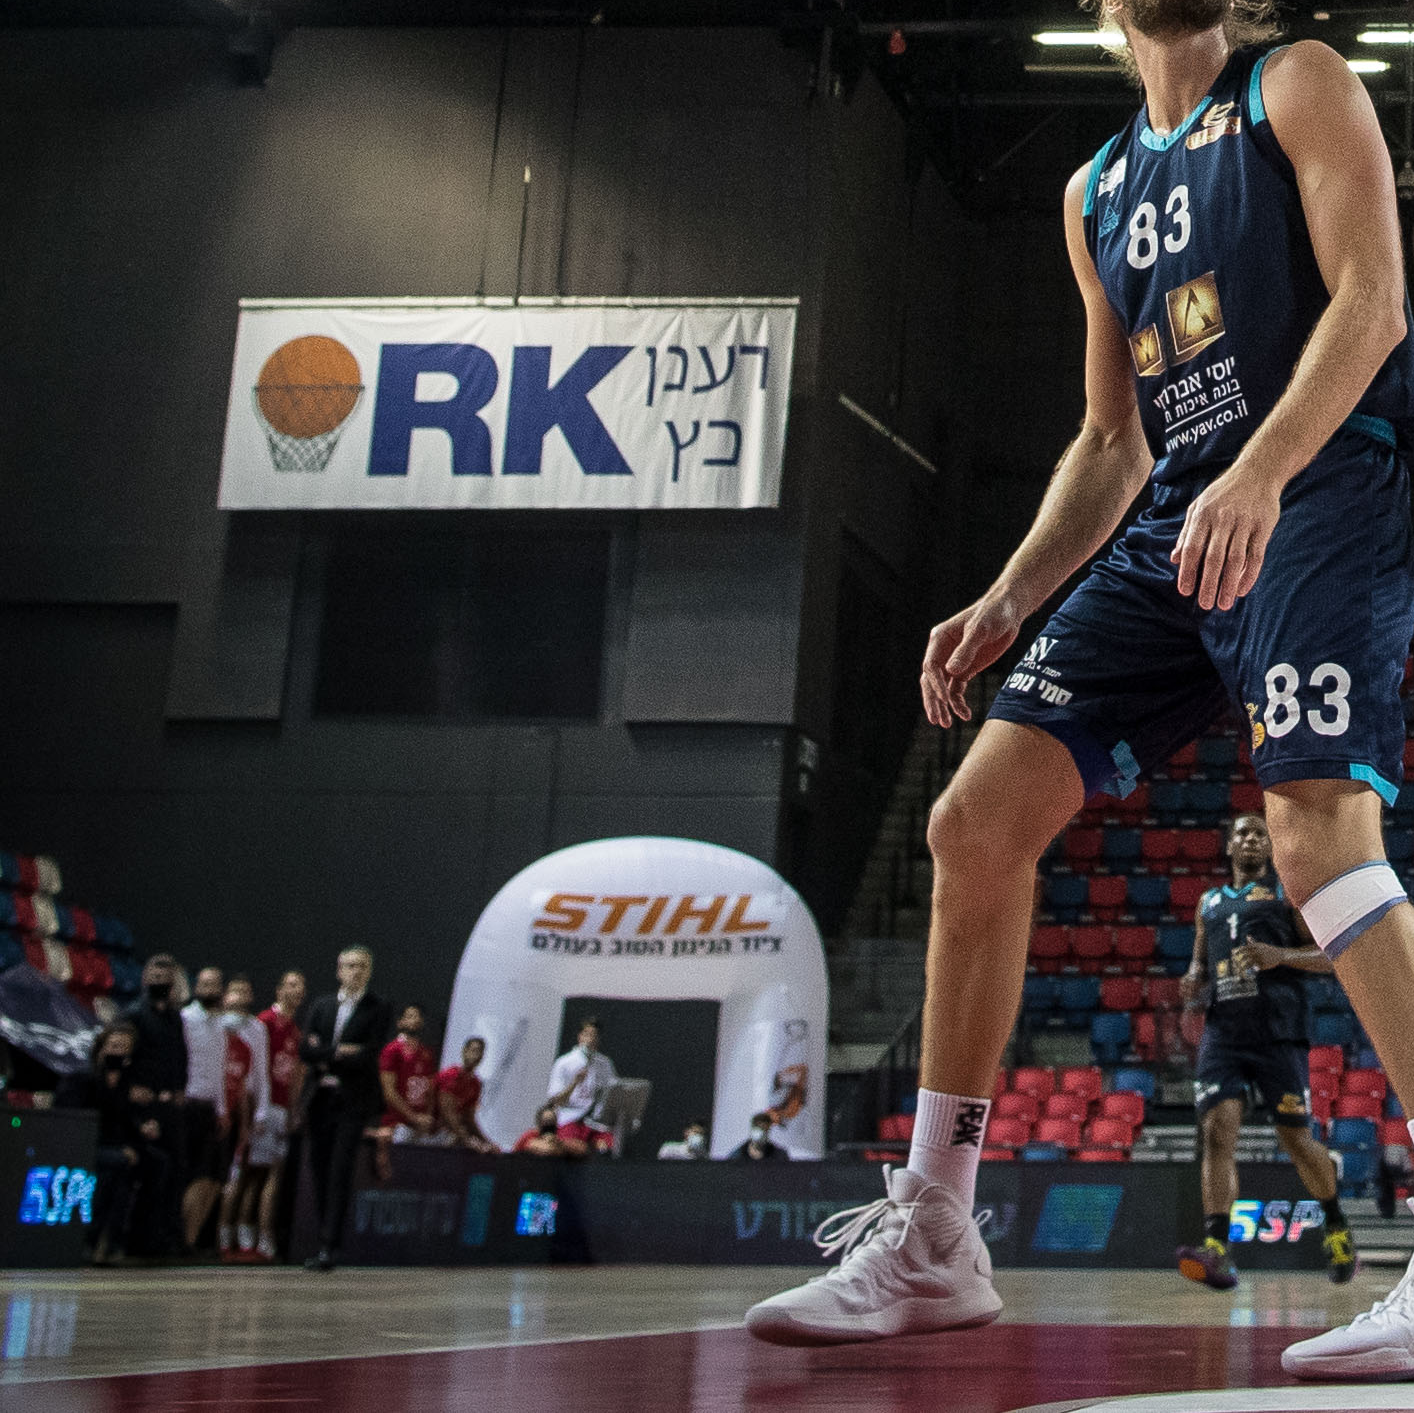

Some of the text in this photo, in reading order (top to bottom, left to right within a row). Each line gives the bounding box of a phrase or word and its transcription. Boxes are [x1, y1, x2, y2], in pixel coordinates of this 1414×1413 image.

[1126, 184, 1192, 269] 83
[645, 344, 769, 406] רענן
[1205, 355, 1236, 381] יוסי
[1212, 378, 1241, 401] בונה
[367, 343, 635, 476] RK
[1175, 392, 1210, 418] איכות
[664, 420, 742, 483] כץ
[1264, 663, 1352, 739] 83
[532, 893, 771, 936] STIHL
[1226, 912, 1240, 940] 1
[951, 1103, 987, 1148] PEAK
